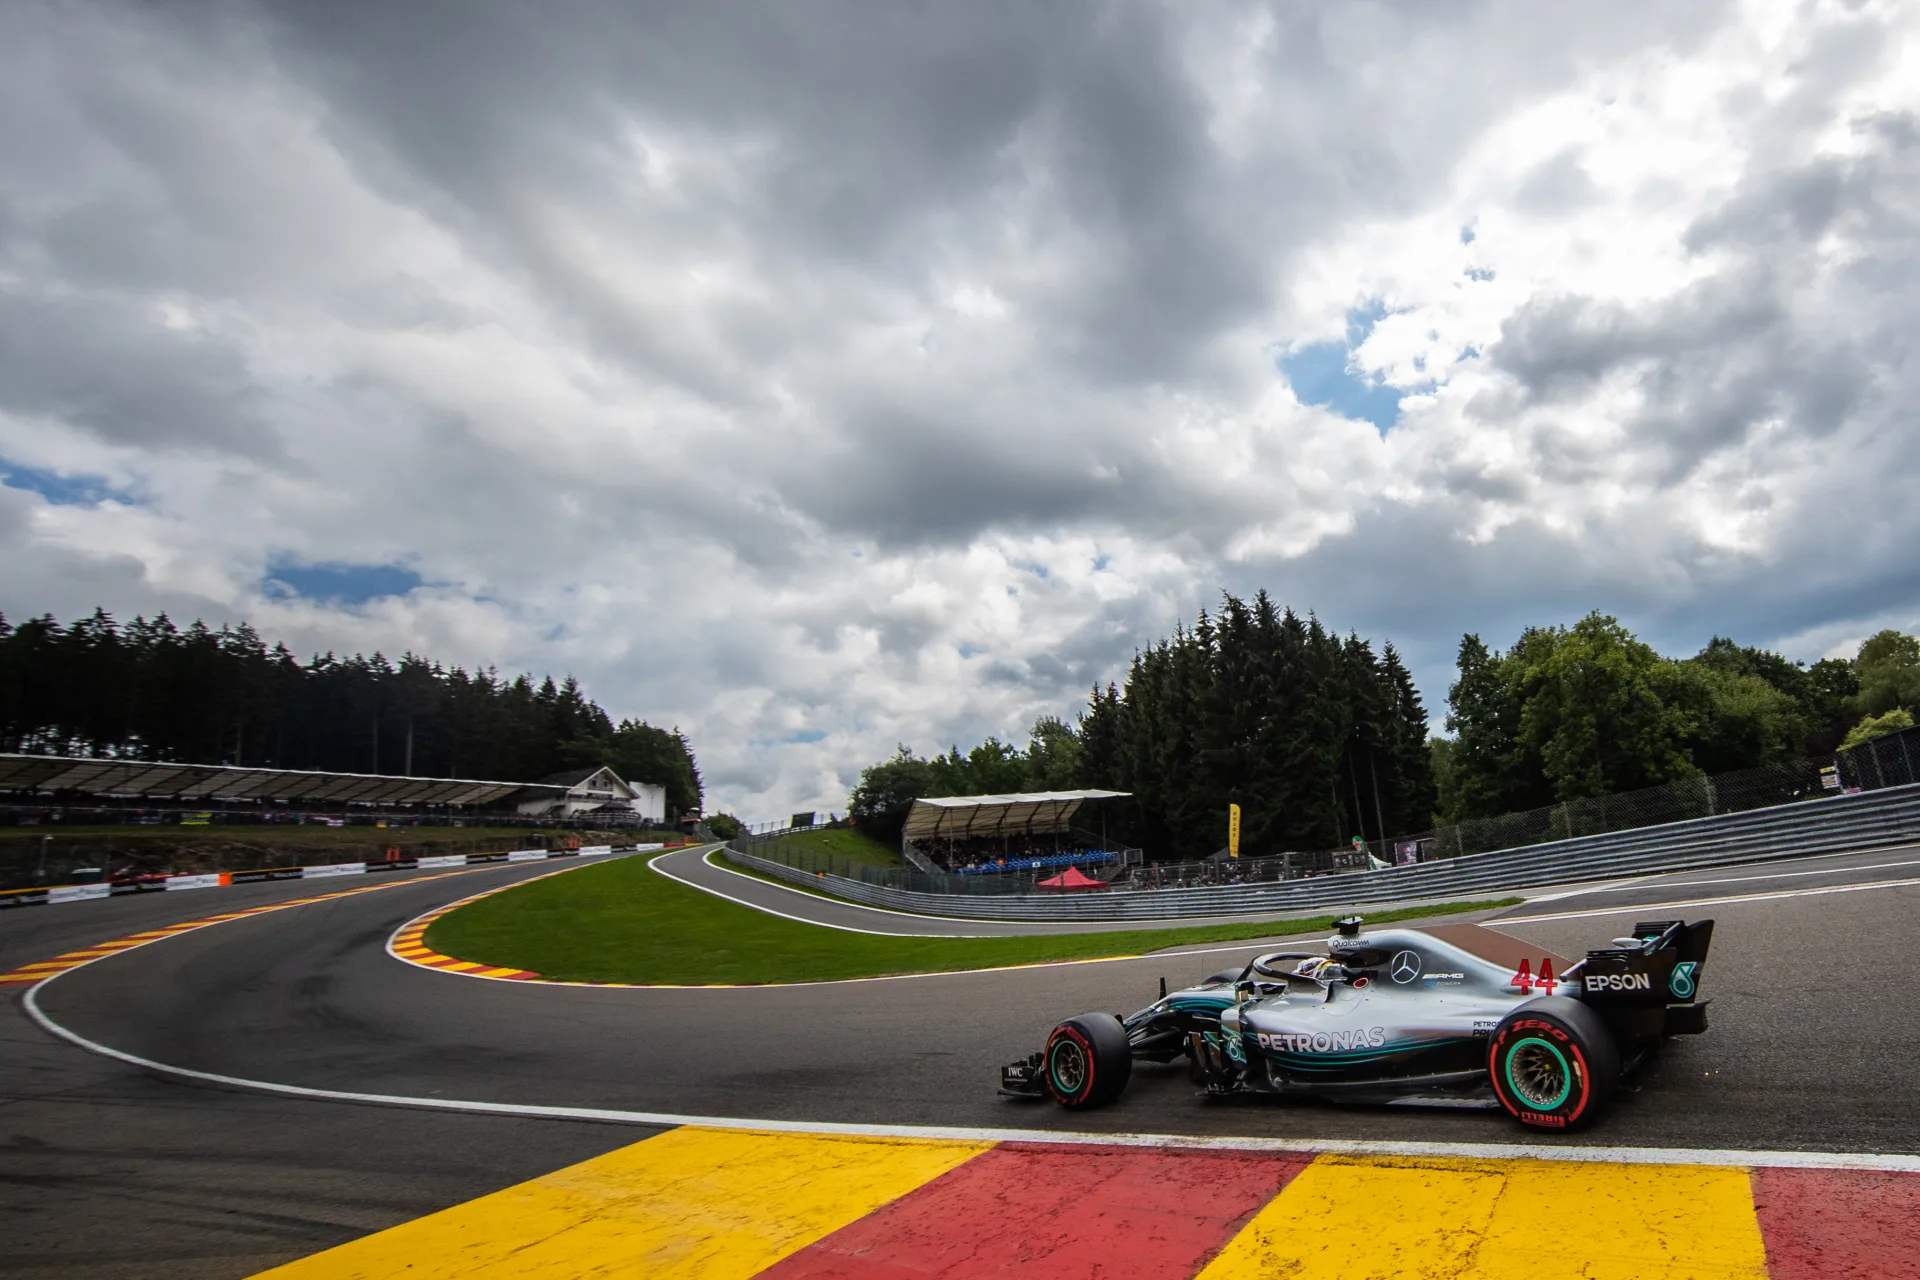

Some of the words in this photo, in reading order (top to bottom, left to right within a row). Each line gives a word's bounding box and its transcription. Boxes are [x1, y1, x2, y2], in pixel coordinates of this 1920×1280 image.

[1332, 940, 1370, 948] Qualcomm
[1511, 958, 1558, 996] 44
[1585, 973, 1650, 991] EPSON
[1473, 1020, 1500, 1028] PETRO
[1512, 1019, 1569, 1040] ZERO
[1257, 1026, 1385, 1053] PETRONAS
[1008, 1067, 1023, 1077] IWC
[1521, 1111, 1565, 1127] PIRELLI
